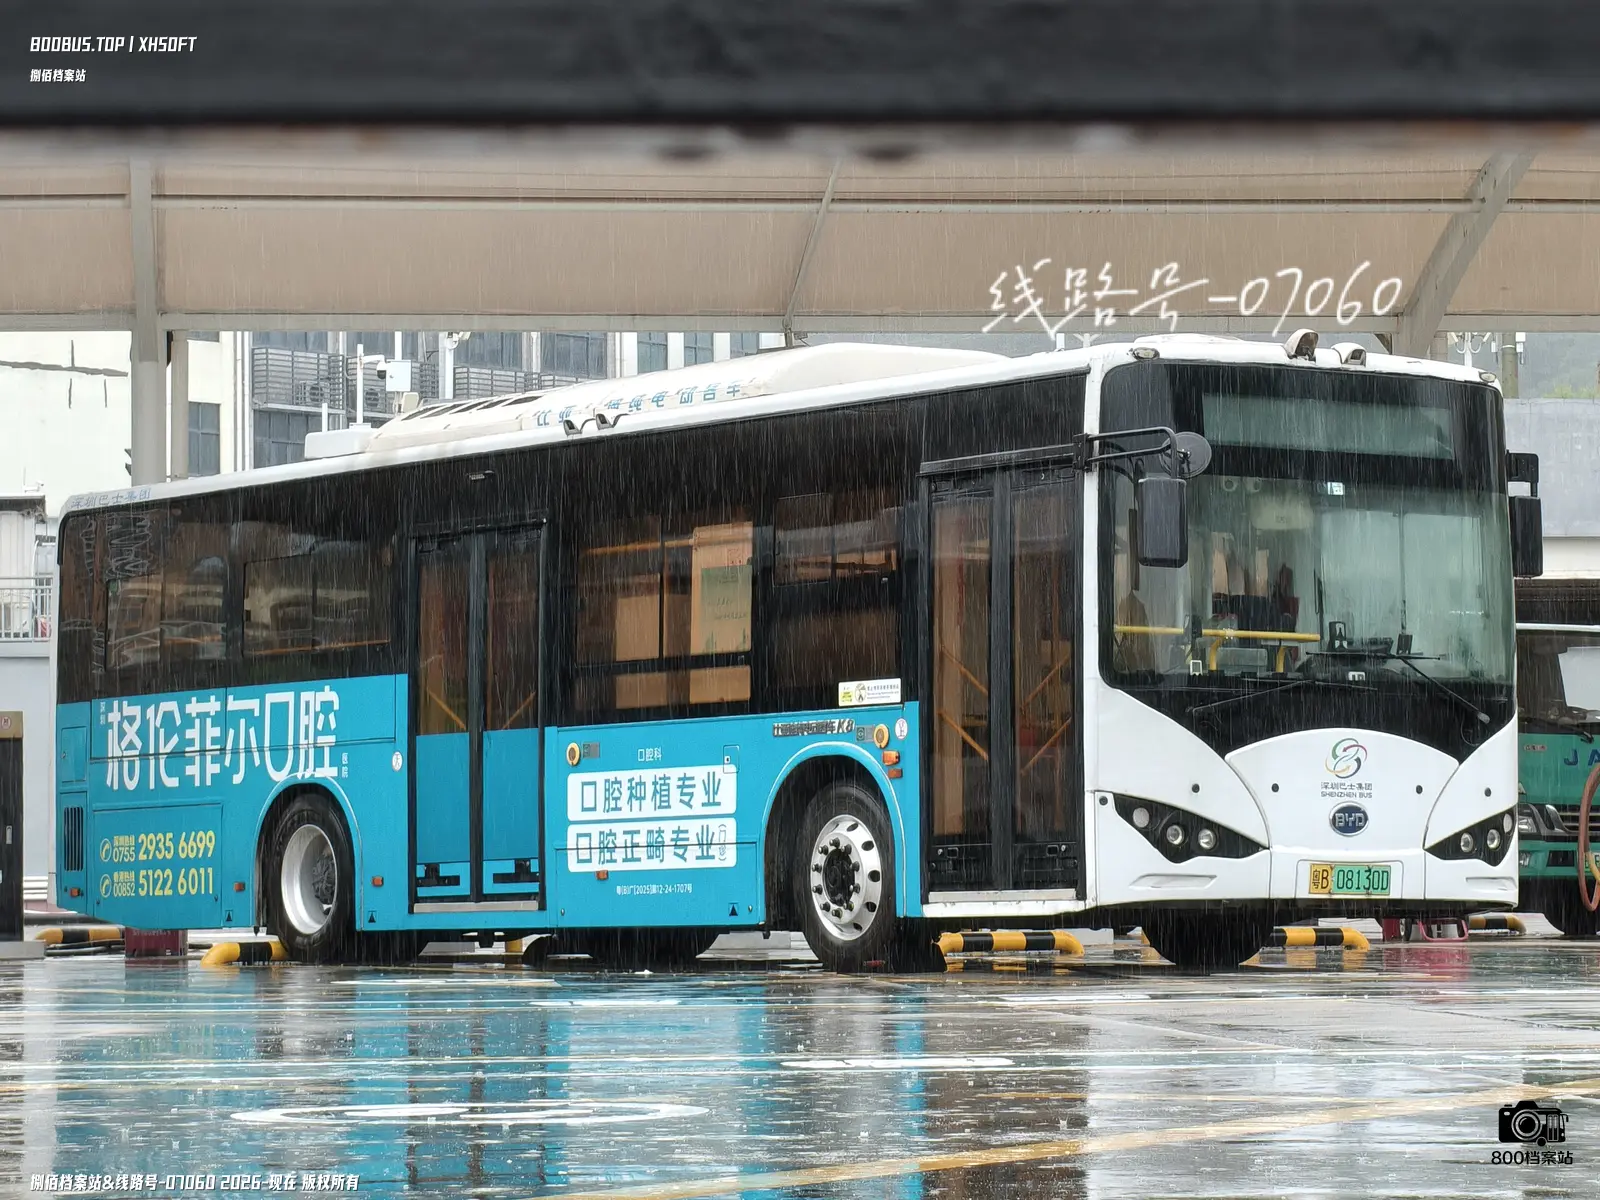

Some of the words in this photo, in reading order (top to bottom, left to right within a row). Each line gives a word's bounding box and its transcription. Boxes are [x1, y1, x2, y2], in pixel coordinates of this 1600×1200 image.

[106, 685, 340, 791] 格伦菲尔口腔
[637, 747, 662, 762] 口腔科
[580, 770, 722, 814] 口腔种植专业
[1320, 781, 1373, 791] 深圳巴士集团
[1334, 812, 1366, 827] BYD
[113, 847, 135, 862] 0755
[138, 833, 174, 861] 2935
[178, 830, 215, 859] 6699
[575, 823, 716, 866] 口腔正畸专业
[113, 882, 135, 897] 00852
[138, 869, 173, 896] 5122
[178, 867, 213, 895] 6011
